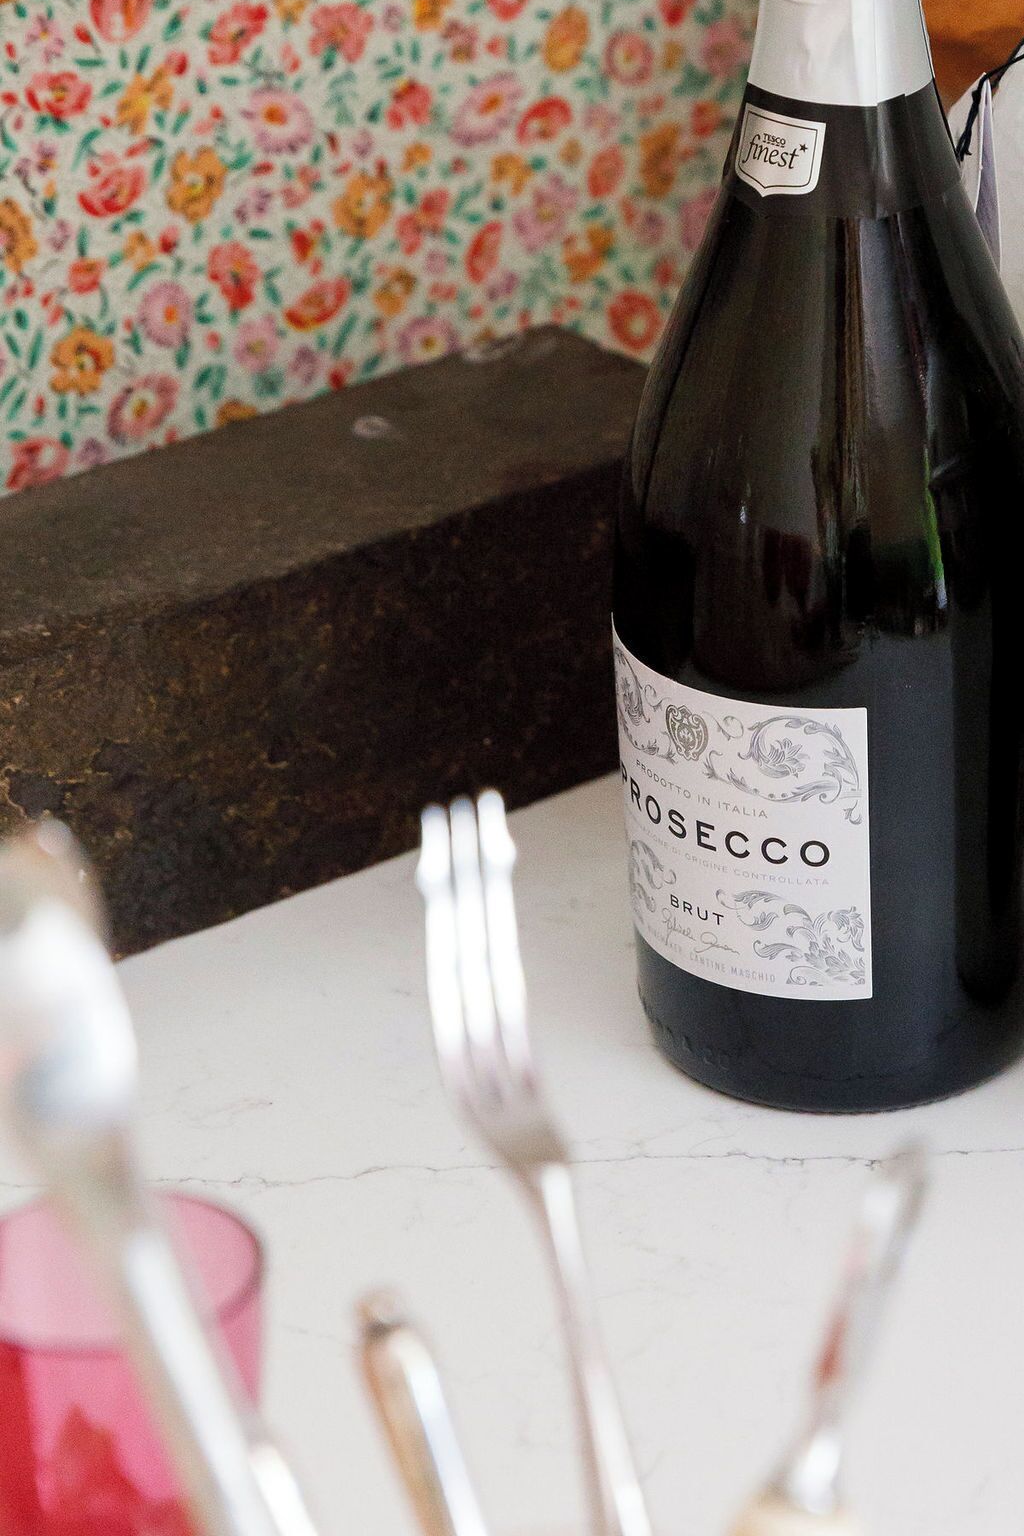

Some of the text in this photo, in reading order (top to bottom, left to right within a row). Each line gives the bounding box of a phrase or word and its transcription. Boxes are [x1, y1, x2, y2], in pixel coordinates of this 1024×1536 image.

[762, 133, 786, 146] TESCO
[636, 759, 768, 819] PRODOTTO IN ITALIA
[620, 760, 830, 867] PROSECCO
[684, 852, 729, 874] ORIGINE
[733, 869, 830, 885] CONTROLLATA
[670, 894, 724, 925] BRUT
[689, 952, 776, 983] CANTINE MASCHIO
